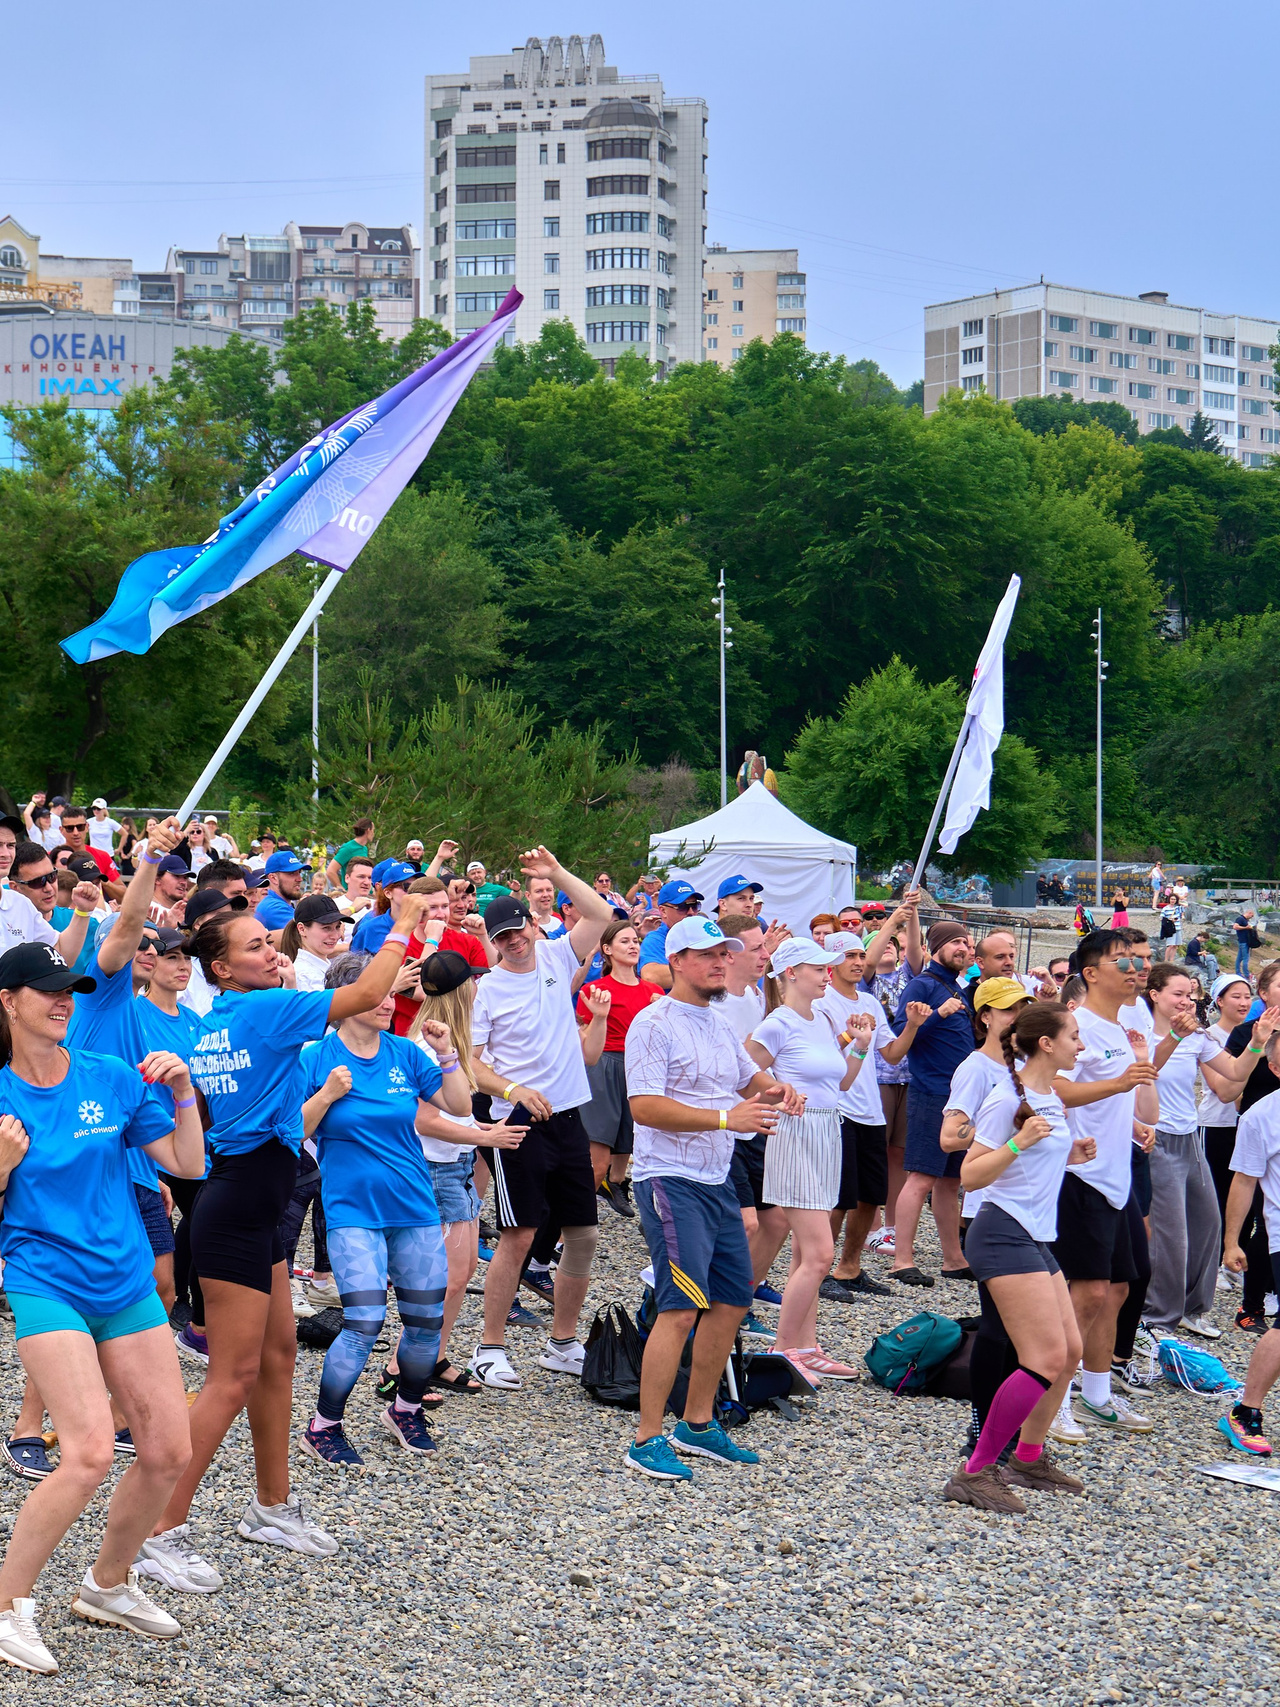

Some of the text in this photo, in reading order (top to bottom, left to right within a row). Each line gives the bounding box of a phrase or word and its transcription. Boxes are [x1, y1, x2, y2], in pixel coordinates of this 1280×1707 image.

[30, 333, 125, 361] ОКЕАН
[4, 362, 155, 375] КИНОЦЕНТР
[39, 377, 123, 396] IMAX
[42, 946, 68, 967] LA
